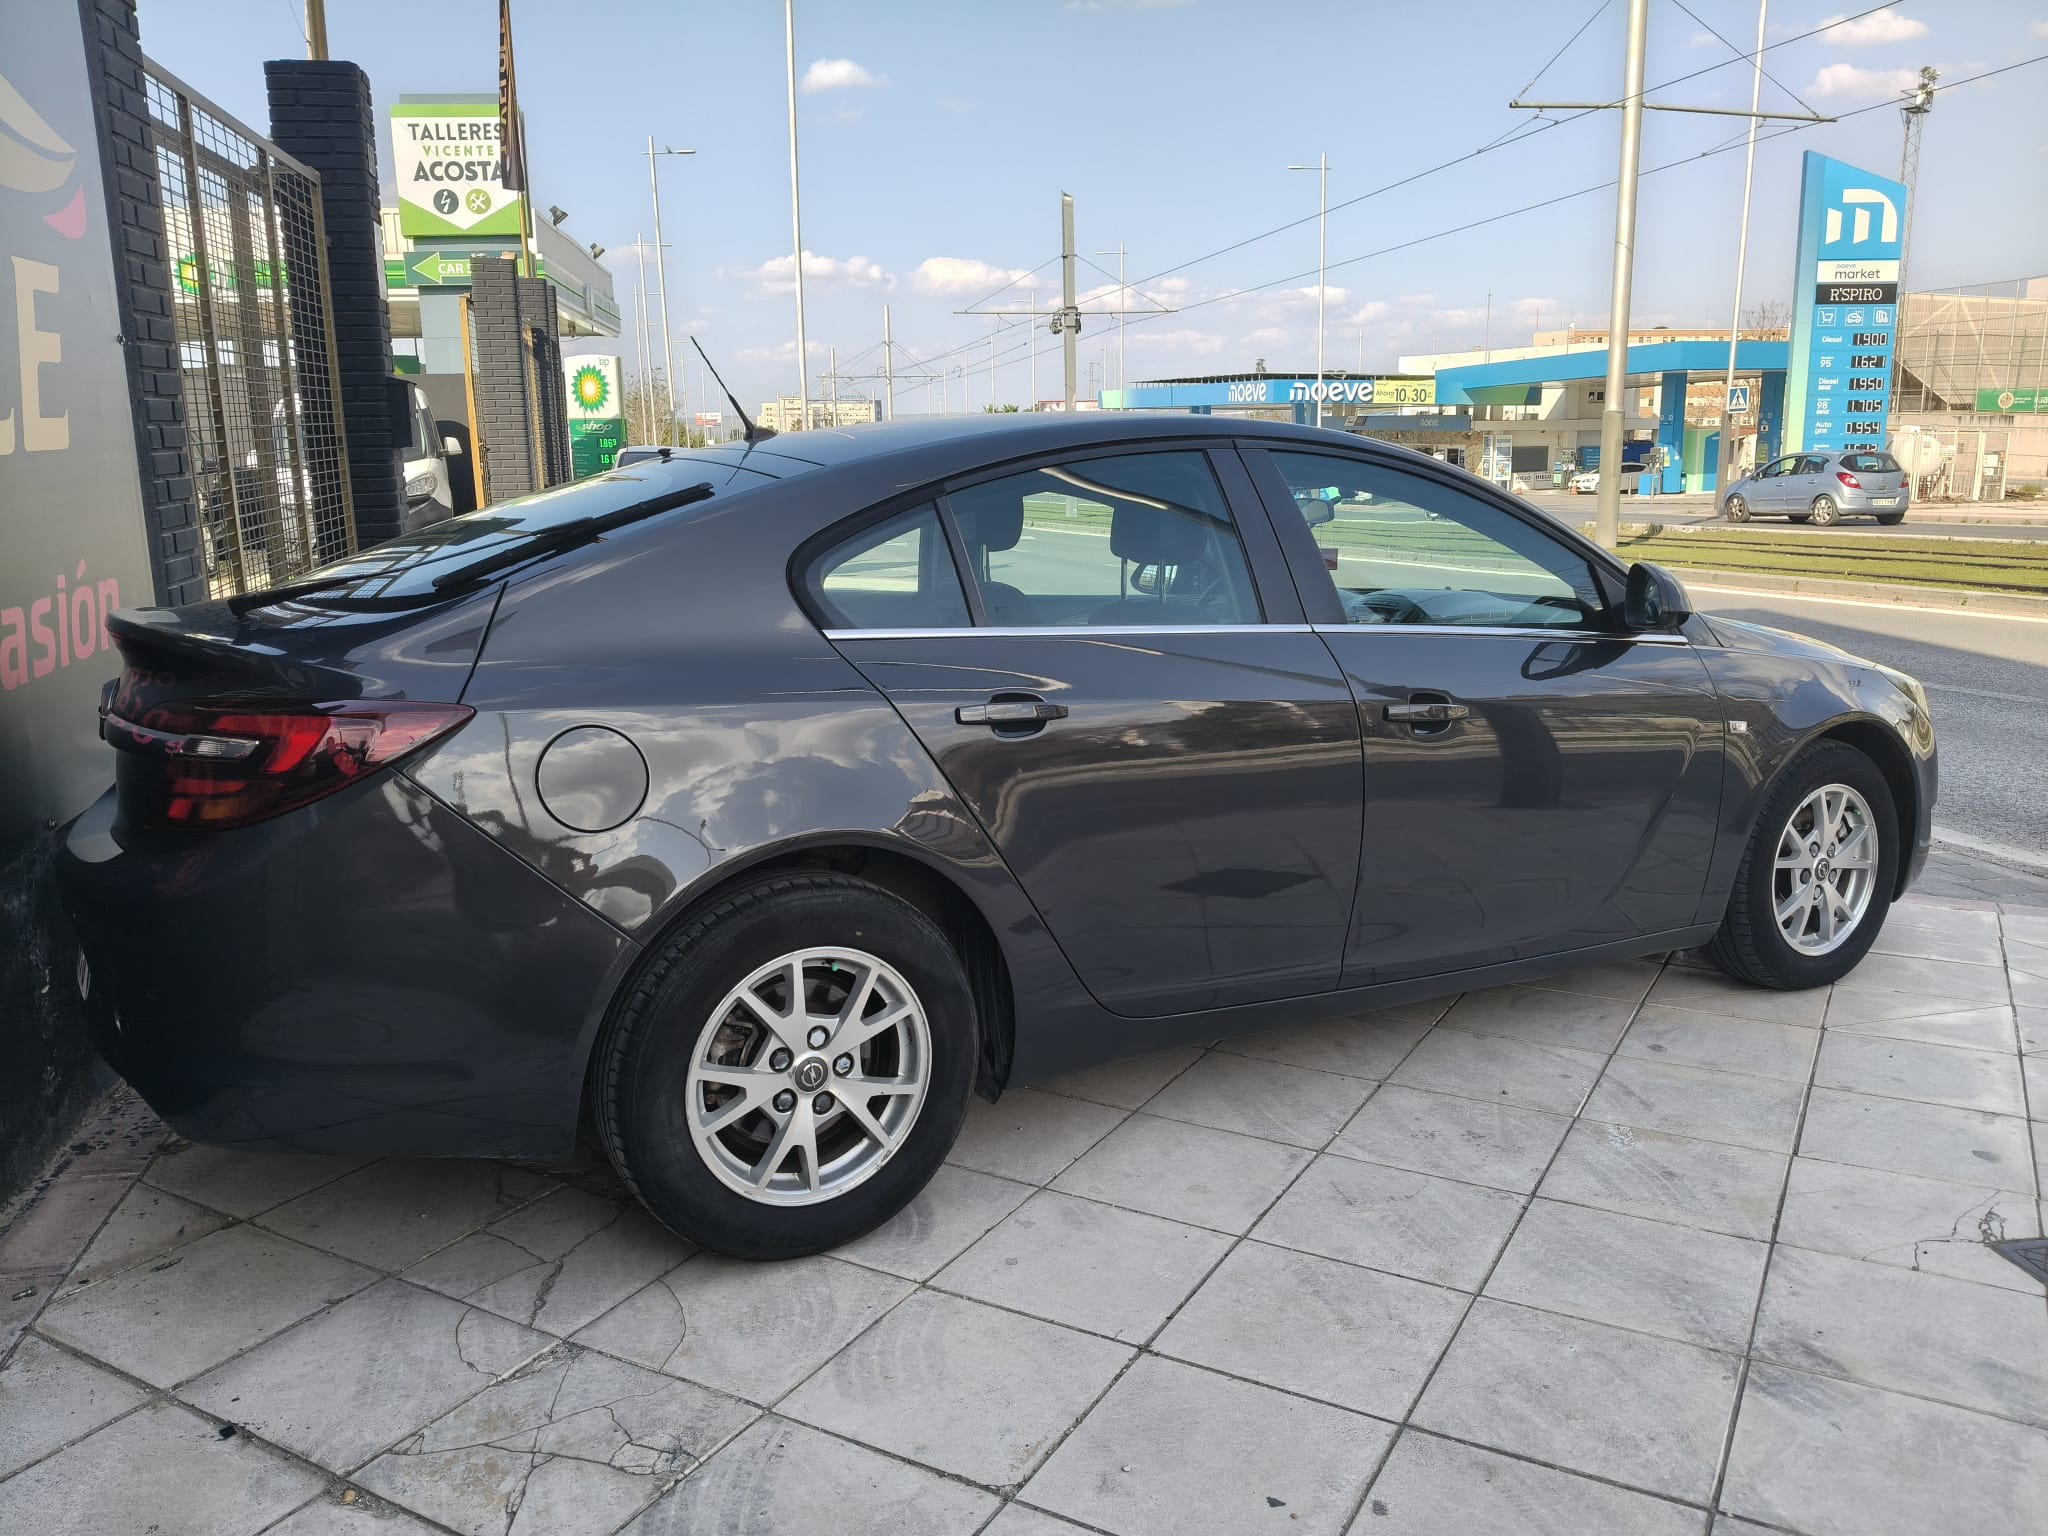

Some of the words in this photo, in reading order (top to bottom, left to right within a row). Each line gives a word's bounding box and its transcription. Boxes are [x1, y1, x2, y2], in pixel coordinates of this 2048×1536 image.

[407, 123, 501, 140] TALLERES
[422, 145, 494, 156] VICENTE
[413, 160, 502, 182] ACOSTA
[437, 263, 464, 274] CAR
[1834, 268, 1881, 280] market
[1829, 287, 1883, 301] R'SPIRO
[1853, 333, 1888, 346] 1.900
[599, 357, 610, 367] bp
[1820, 359, 1832, 368] 95
[1852, 355, 1886, 368] 1.621
[1818, 377, 1839, 385] Diesel
[1851, 378, 1884, 390] 1.950
[1228, 382, 1267, 402] moeve
[1289, 382, 1374, 402] moeve
[1395, 388, 1407, 402] 10
[1411, 388, 1427, 402] 30
[1848, 400, 1882, 412] 1.705
[582, 420, 613, 433] shop
[1845, 422, 1881, 434] 0.954
[0, 558, 120, 691] asión
